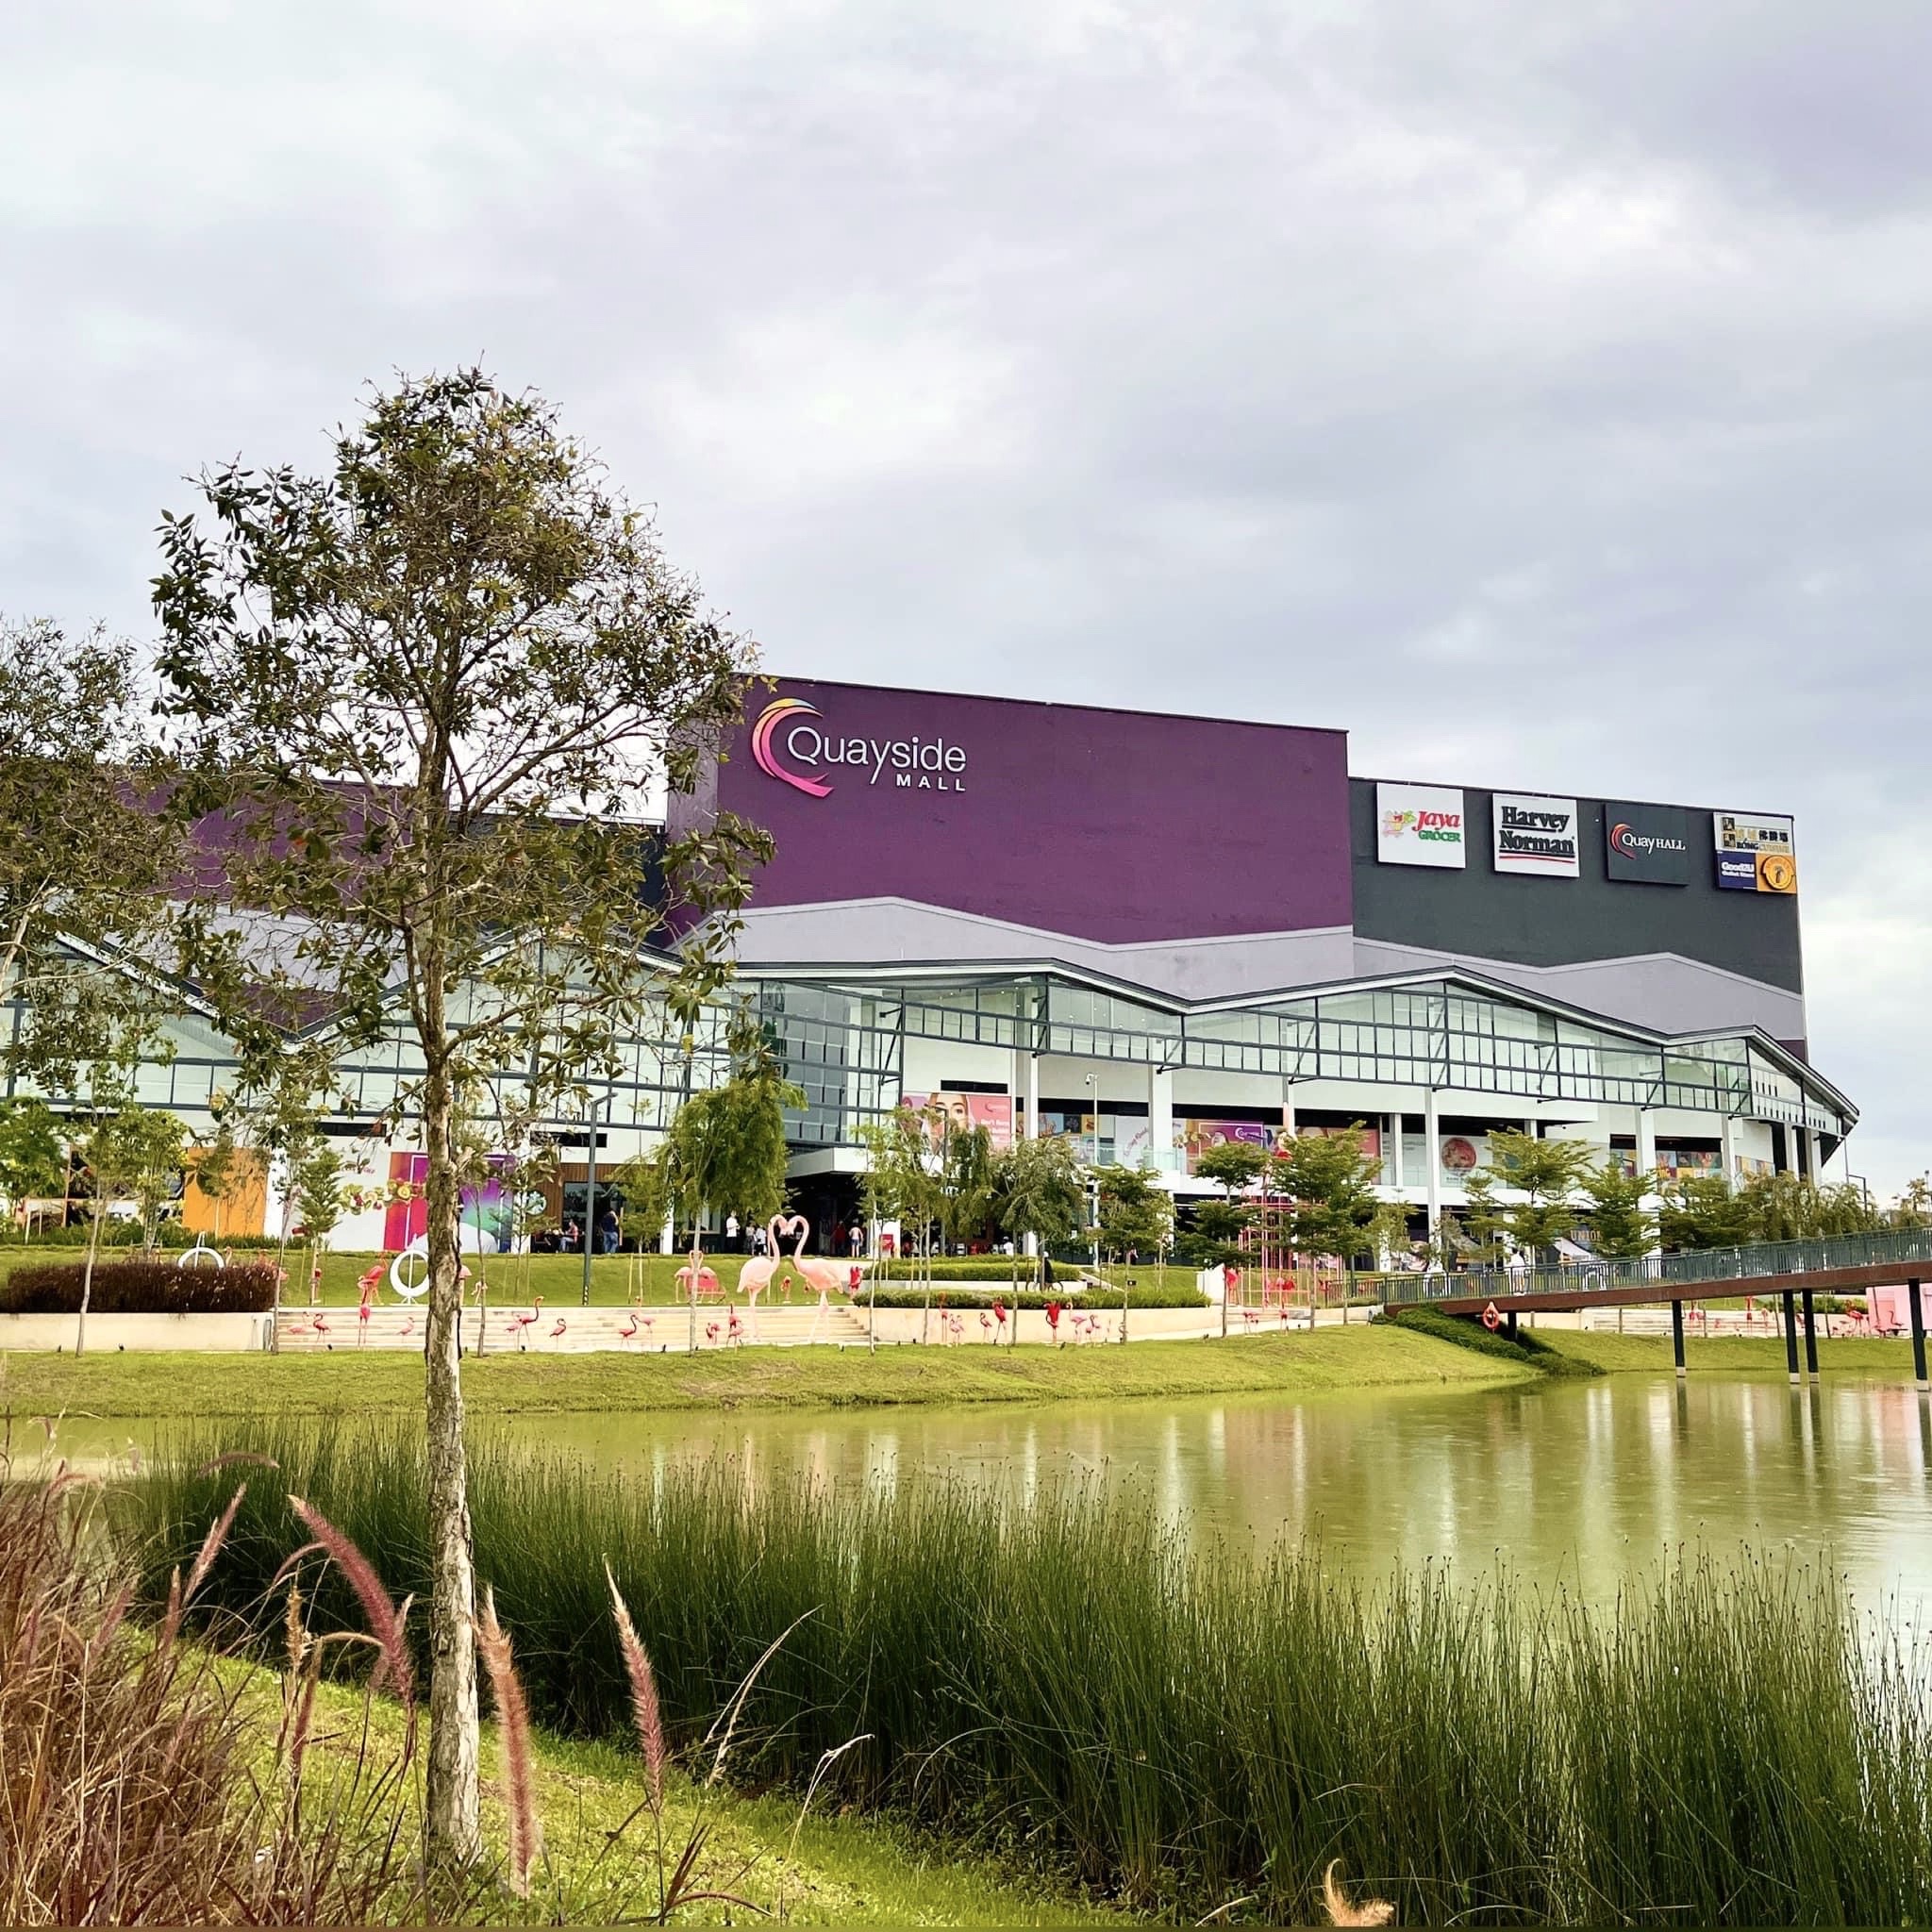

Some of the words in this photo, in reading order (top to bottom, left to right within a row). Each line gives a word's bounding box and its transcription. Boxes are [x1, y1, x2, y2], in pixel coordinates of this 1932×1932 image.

[787, 725, 967, 785] Quayside
[896, 774, 966, 791] MALL
[1412, 810, 1461, 831] Jaya
[1501, 806, 1570, 833] Harvey
[1418, 829, 1461, 842] GROCER
[1498, 829, 1574, 854] Norman
